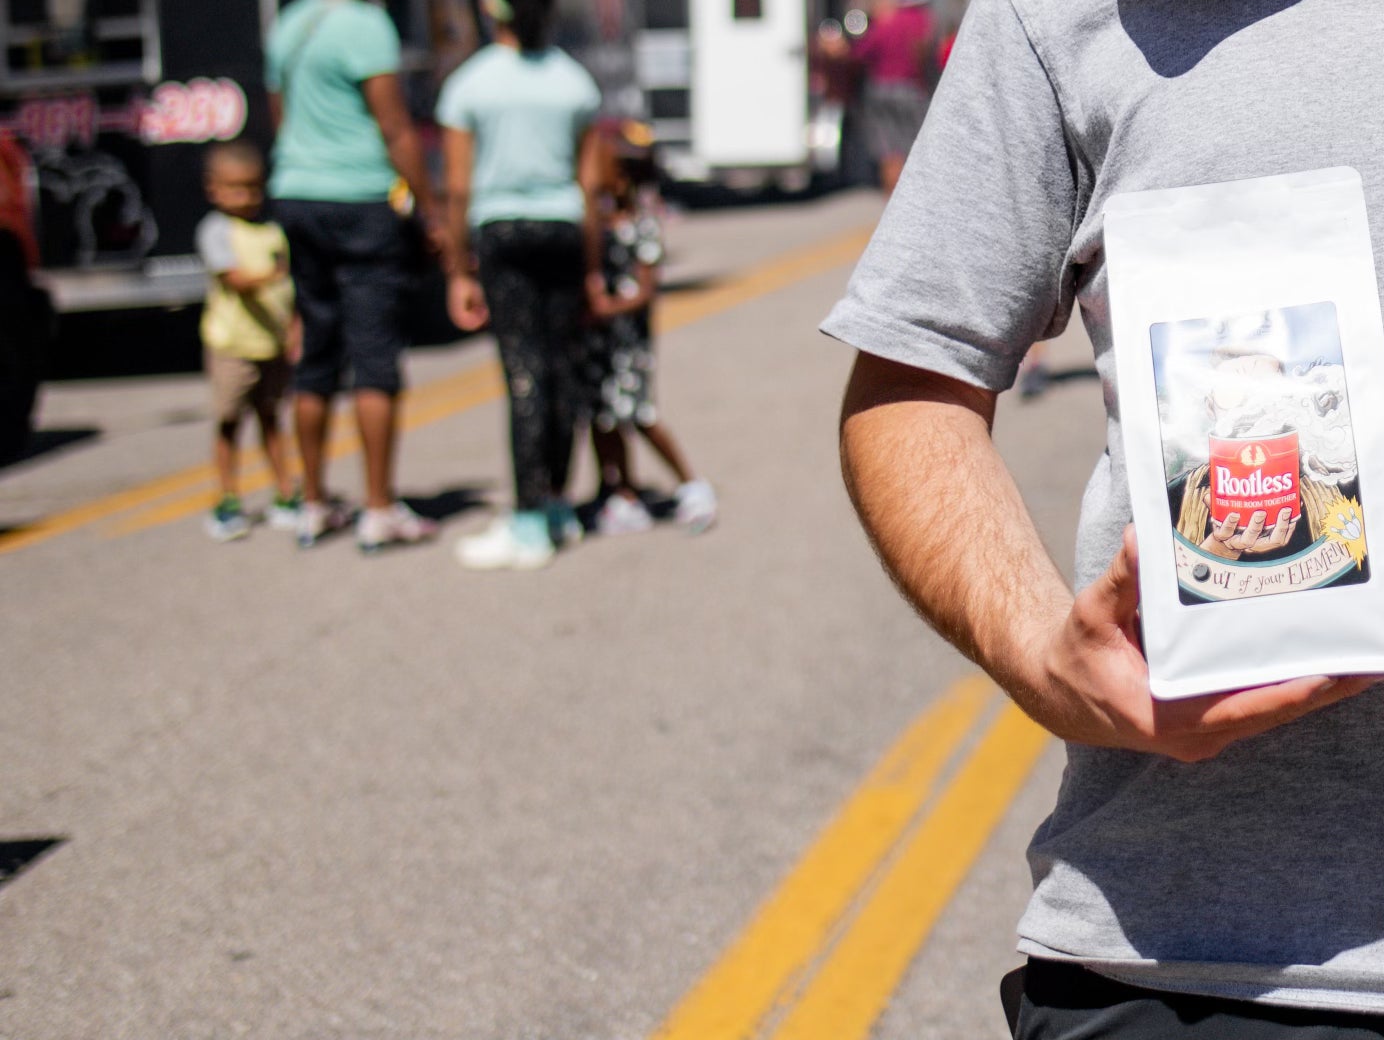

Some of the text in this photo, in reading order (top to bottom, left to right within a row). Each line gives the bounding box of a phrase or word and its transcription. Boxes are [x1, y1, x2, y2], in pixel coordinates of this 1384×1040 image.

[1215, 465, 1293, 497] Rootless
[1231, 500, 1243, 509] THE
[1263, 493, 1297, 507] TOGETHER
[1238, 574, 1253, 594] of
[1254, 573, 1285, 593] your
[1287, 540, 1352, 585] ELEMENT
